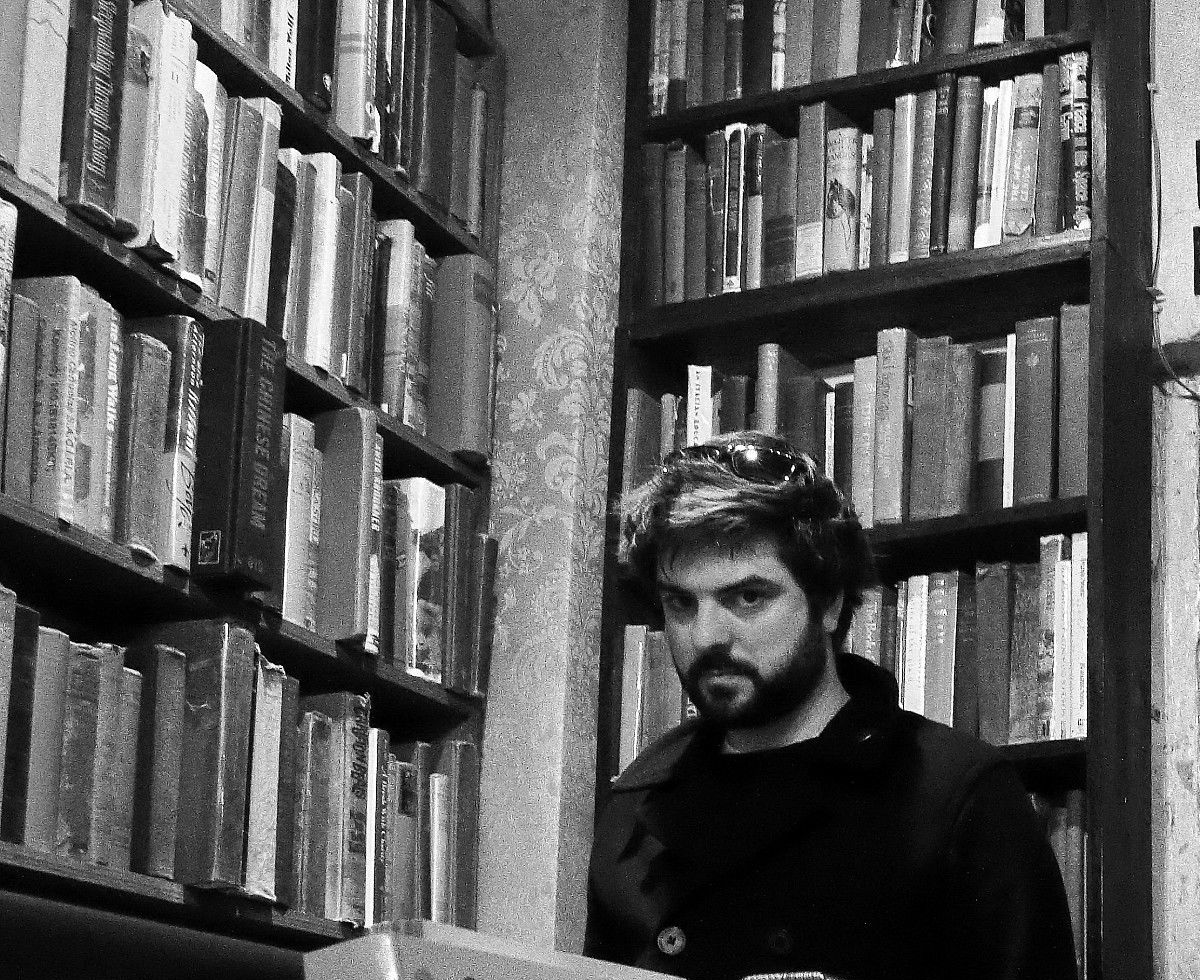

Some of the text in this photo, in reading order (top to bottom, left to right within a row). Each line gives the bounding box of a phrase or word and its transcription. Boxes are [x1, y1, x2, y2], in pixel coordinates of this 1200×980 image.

[87, 76, 113, 131] Through
[86, 129, 110, 179] History
[249, 337, 277, 531] THE CHINESE DREAM
